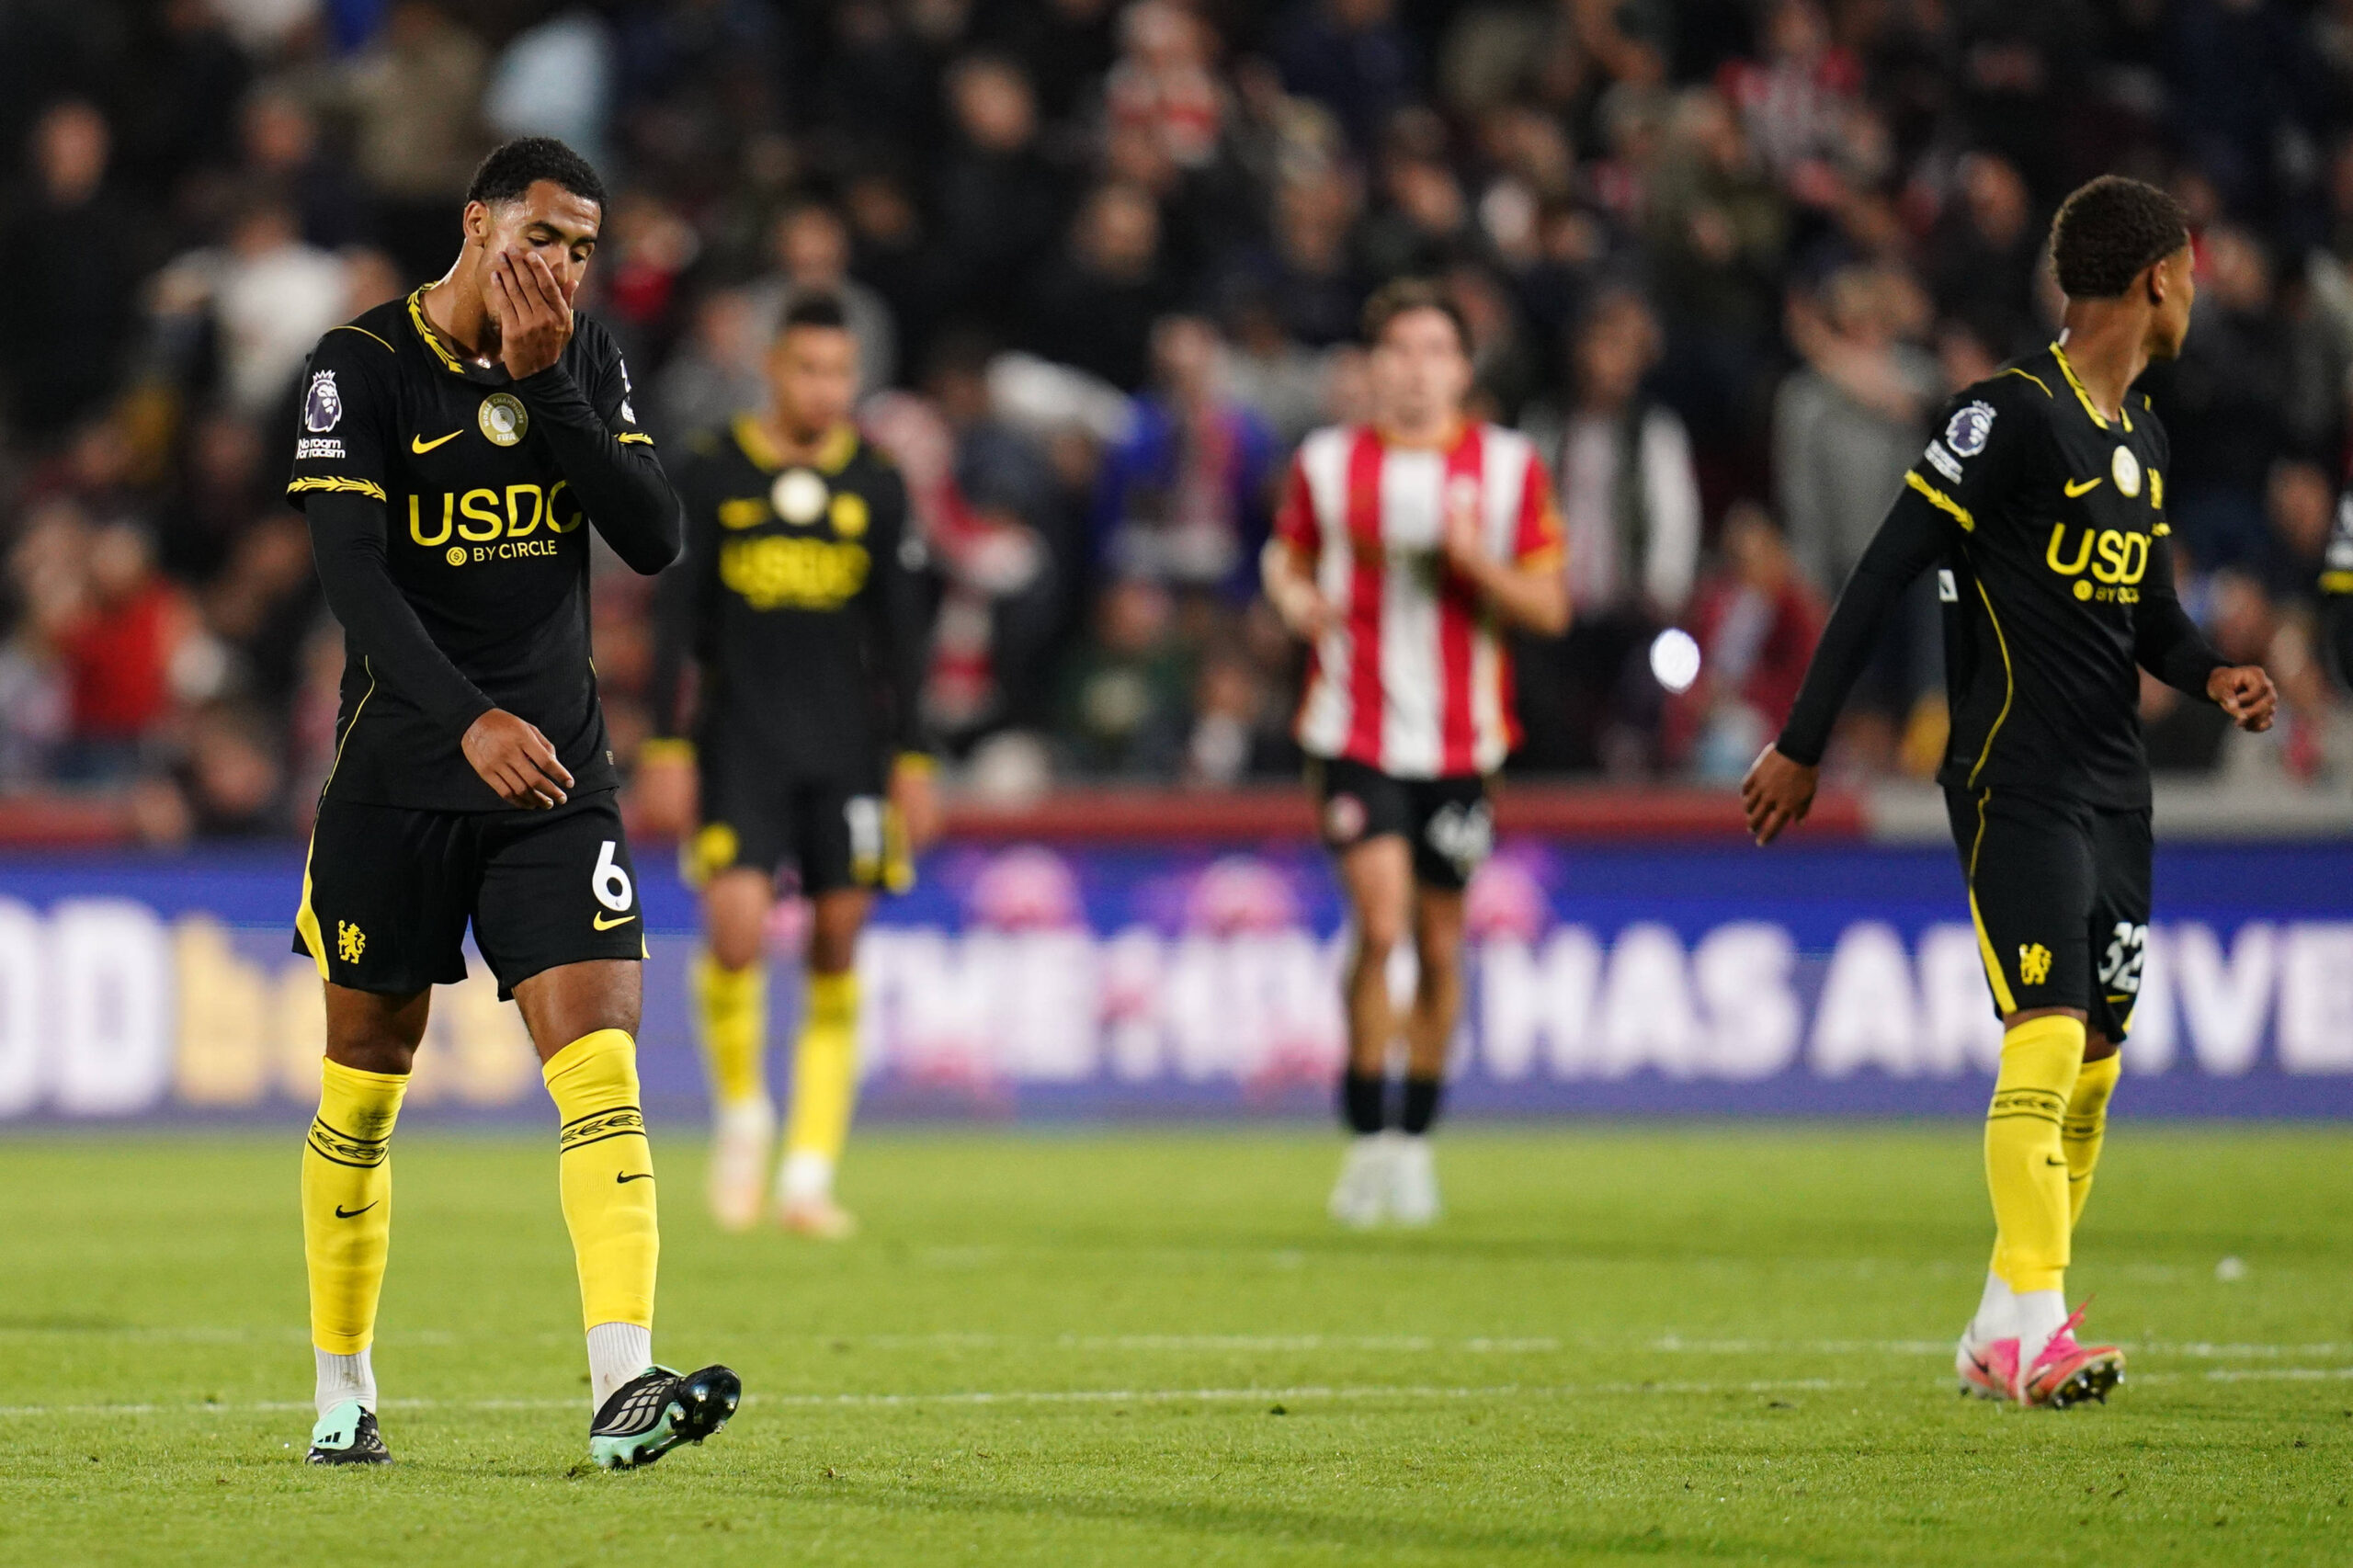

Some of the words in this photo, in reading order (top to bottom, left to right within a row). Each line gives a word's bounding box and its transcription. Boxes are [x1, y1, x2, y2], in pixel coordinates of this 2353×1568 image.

[308, 449, 346, 459] racism
[310, 438, 341, 449] room
[496, 433, 517, 441] FIFA
[409, 480, 582, 546] USDC
[473, 546, 496, 562] BY
[499, 540, 557, 559] CIRCLE
[2046, 522, 2152, 585] USD
[592, 840, 632, 911] 6
[2097, 922, 2149, 993] 32
[1480, 921, 1802, 1077] HAS
